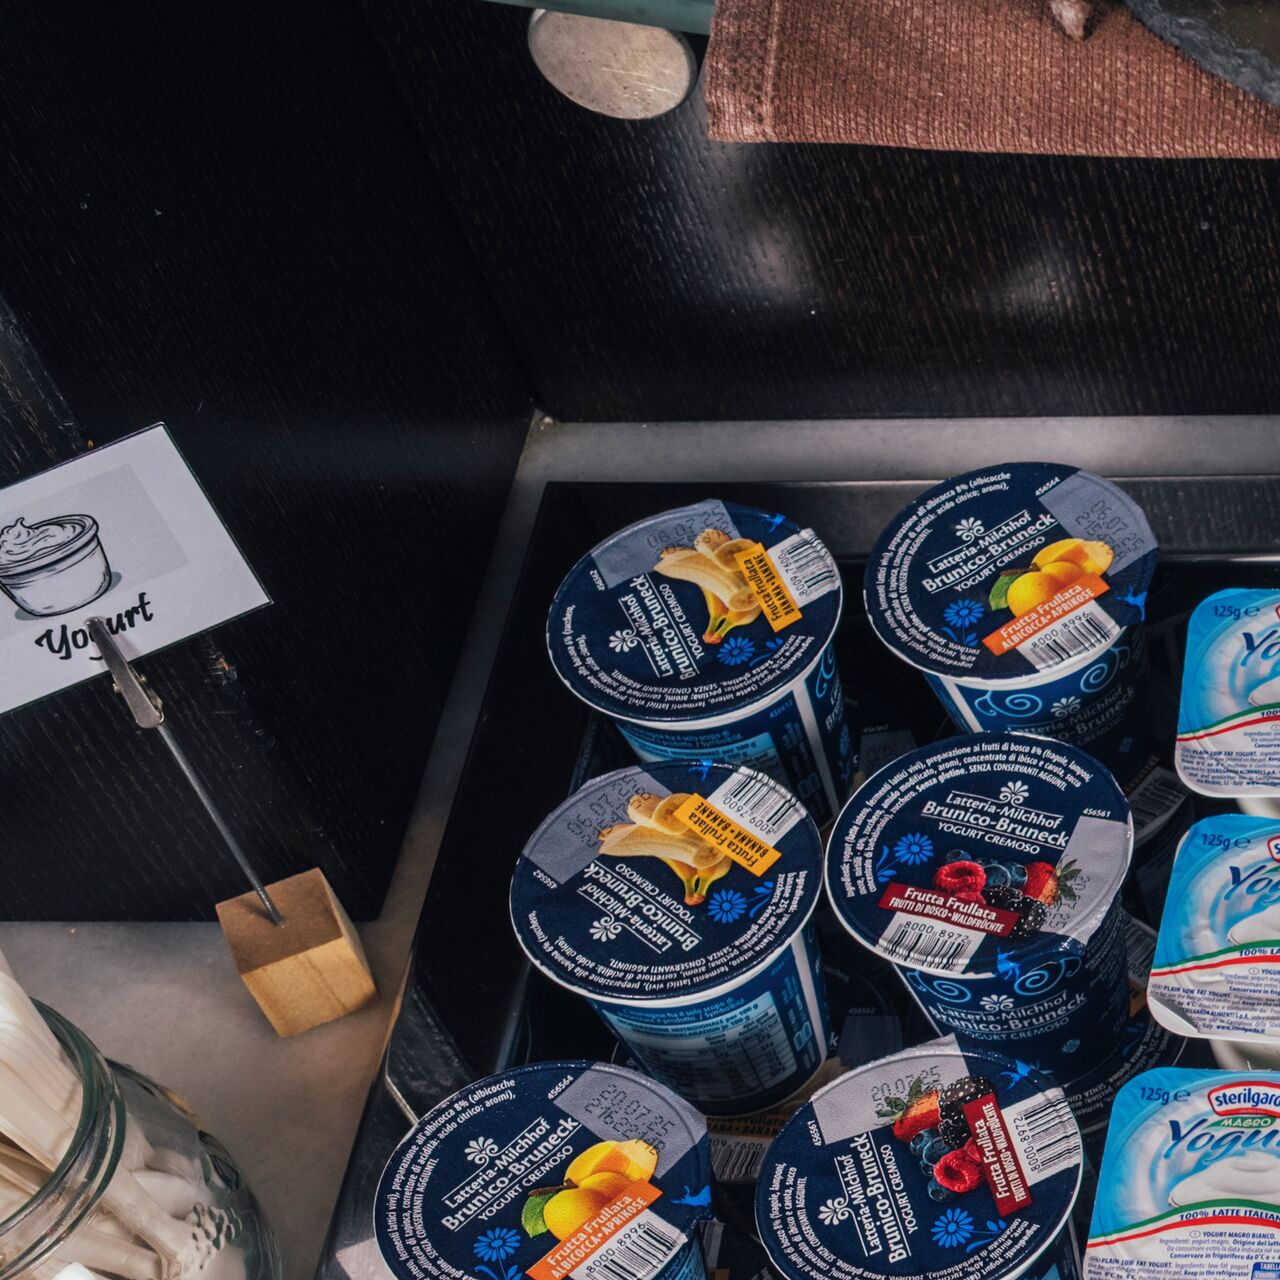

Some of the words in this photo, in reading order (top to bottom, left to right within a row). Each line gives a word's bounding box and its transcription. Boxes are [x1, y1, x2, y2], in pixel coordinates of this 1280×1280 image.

[921, 512, 1057, 594] Brunico-Bruneck
[928, 510, 1033, 574] Latteria-Milchhof
[35, 592, 153, 660] Yourt
[619, 593, 674, 678] Latteria-Milchhof
[631, 575, 697, 680] Brunico-Bruneck
[921, 800, 1069, 847] Brunico-Bruneck
[938, 821, 982, 842] YOGURT
[984, 834, 1040, 854] CREMOSO
[945, 792, 1063, 830] Latteria-Milchhof
[577, 881, 672, 953] Latteria-Milchhof
[584, 863, 701, 952] Brunico-Bruneck
[440, 1115, 580, 1231] Brunico-Bruneck
[444, 1118, 551, 1209] Latteria-Milchhof
[844, 1154, 883, 1256] Latteria-Milchhof
[850, 1132, 905, 1264] Brunico-Bruneck
